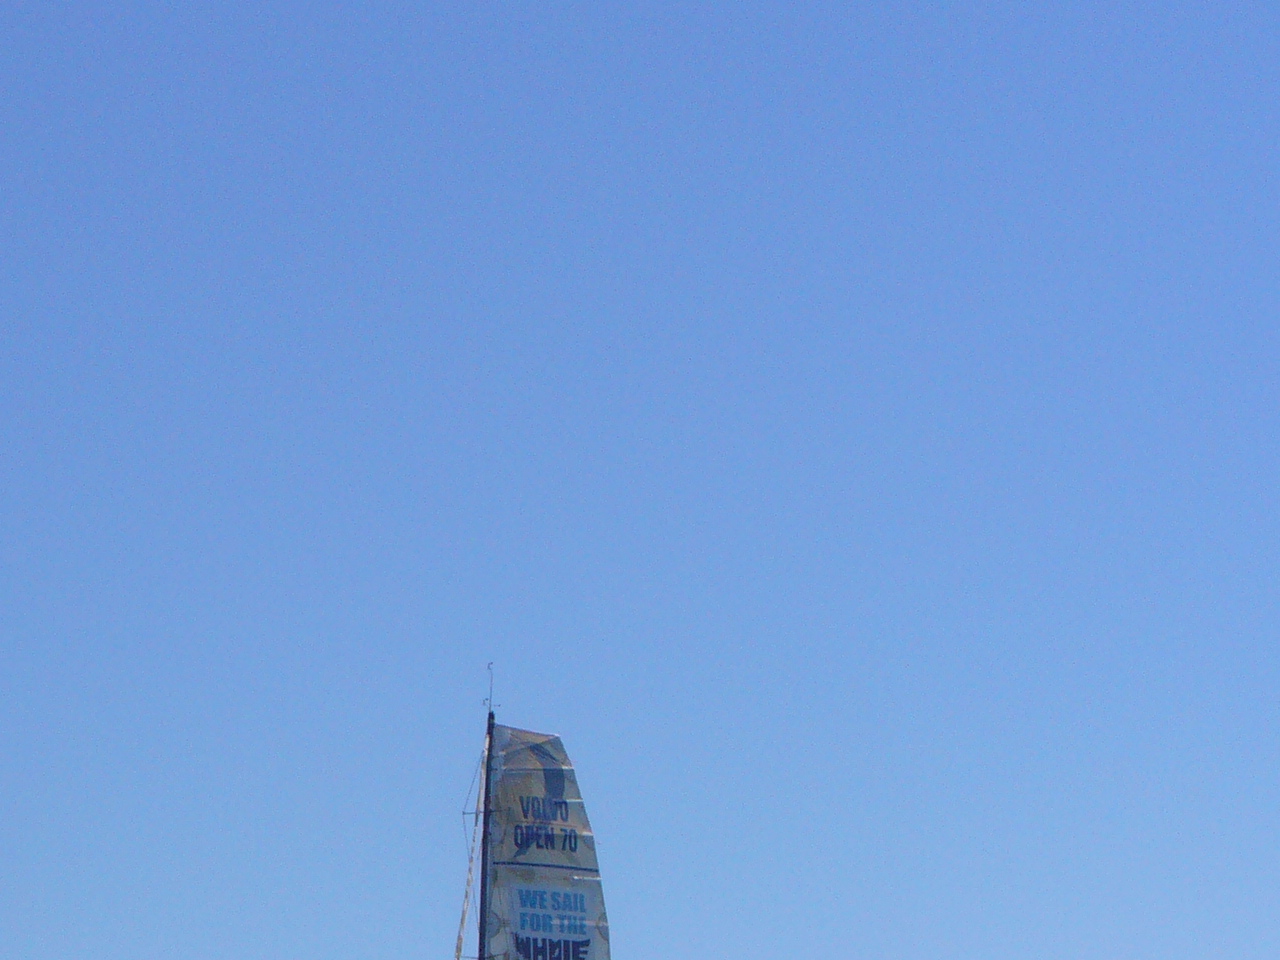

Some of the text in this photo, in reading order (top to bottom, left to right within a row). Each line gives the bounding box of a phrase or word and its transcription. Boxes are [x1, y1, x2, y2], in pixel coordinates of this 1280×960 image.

[519, 795, 569, 822] VOLVO
[513, 824, 578, 853] OPEN 70
[518, 888, 587, 913] WE SAIL
[520, 912, 587, 935] FOR THE
